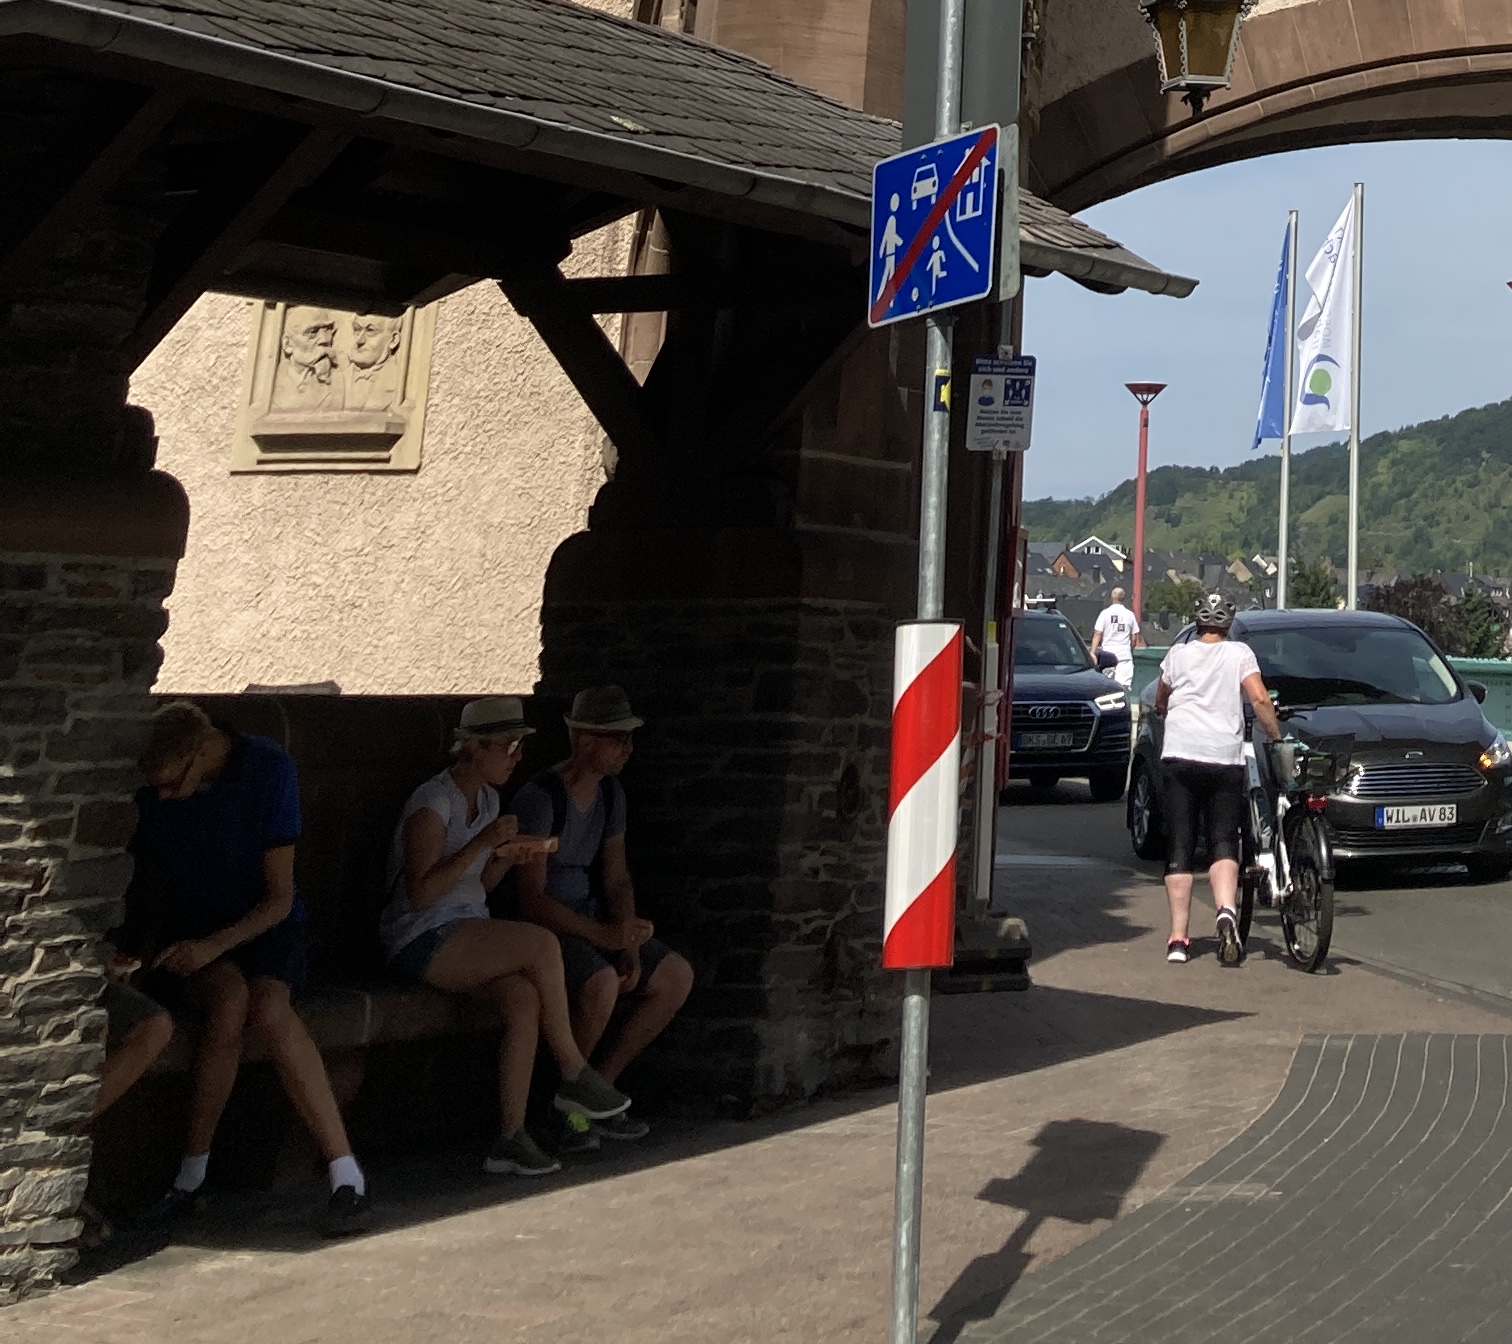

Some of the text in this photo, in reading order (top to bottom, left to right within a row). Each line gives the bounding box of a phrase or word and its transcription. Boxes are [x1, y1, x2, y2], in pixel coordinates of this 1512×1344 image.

[1385, 806, 1455, 824] WIL AV 83
